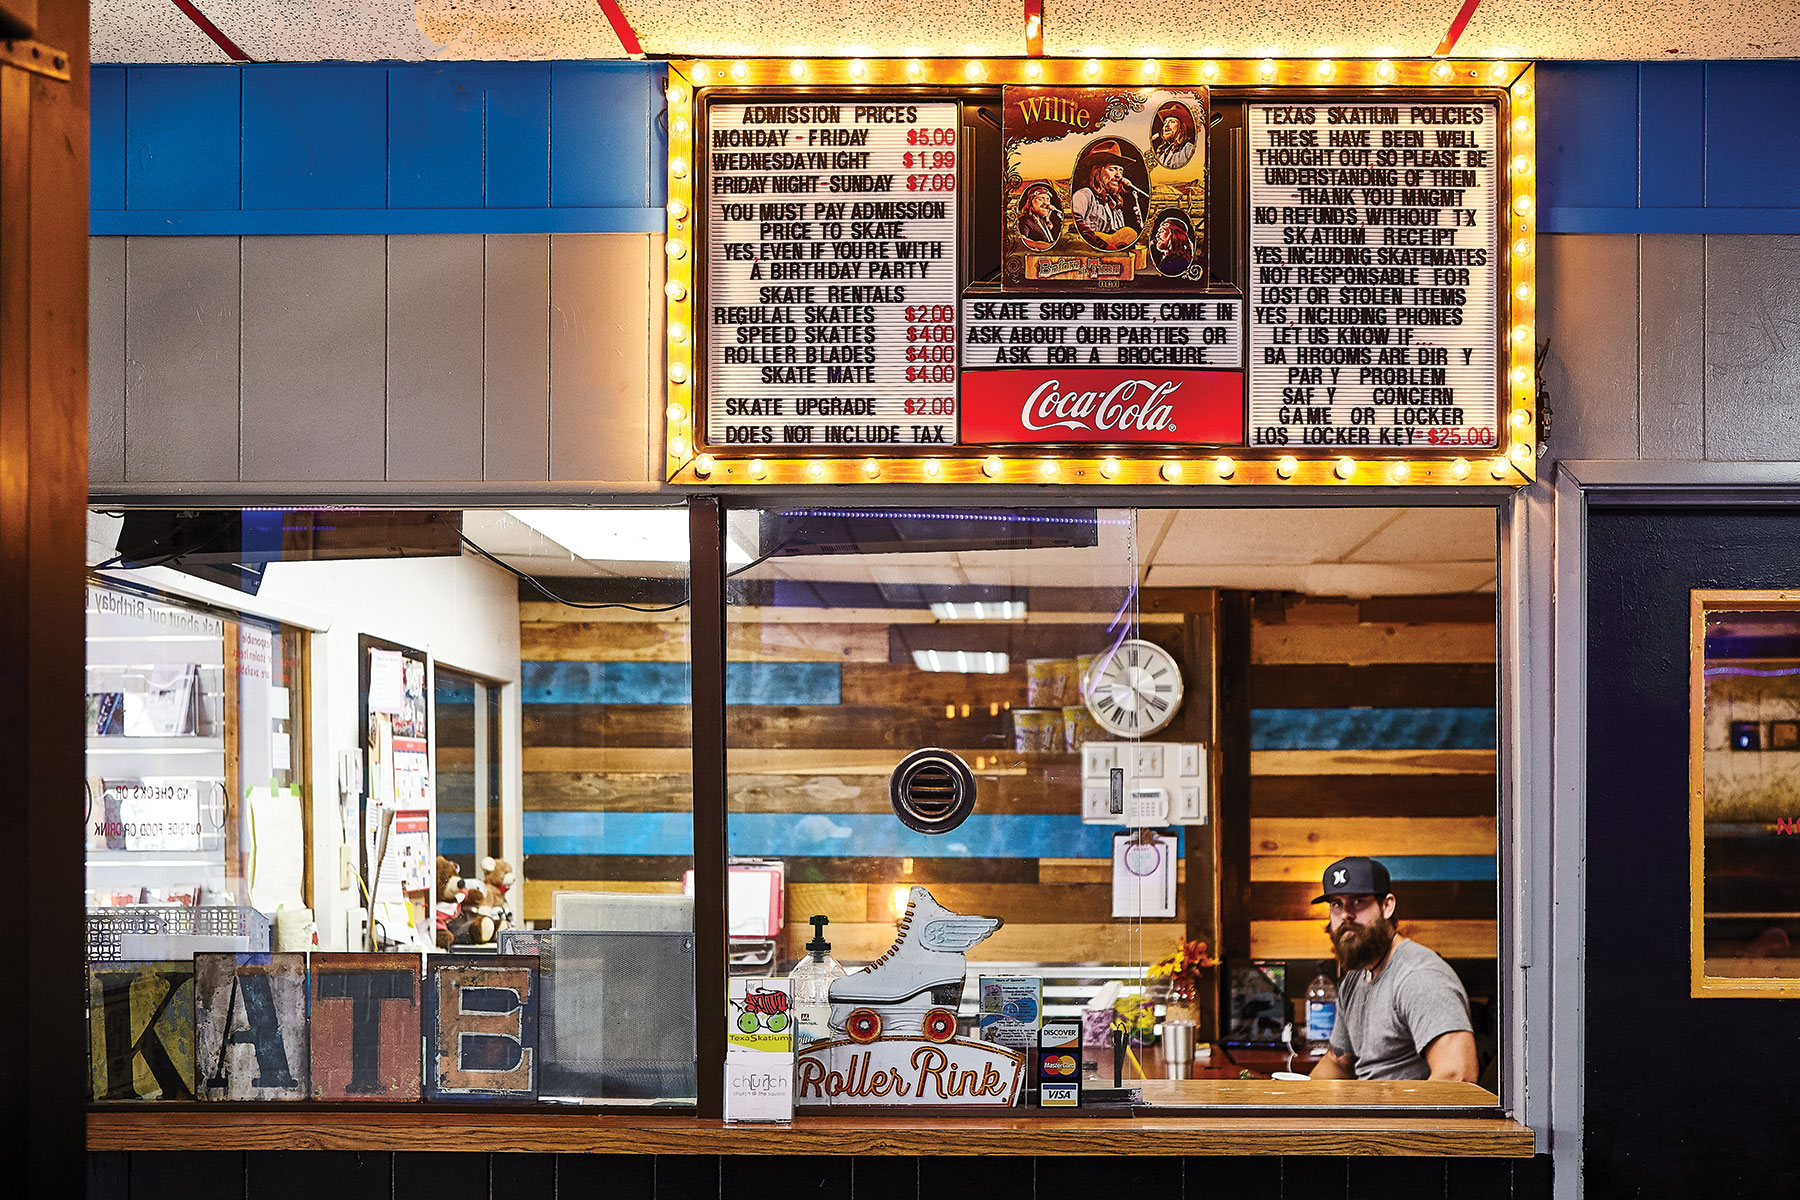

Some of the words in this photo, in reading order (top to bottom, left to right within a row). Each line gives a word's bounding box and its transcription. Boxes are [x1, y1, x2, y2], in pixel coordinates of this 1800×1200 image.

[742, 106, 840, 124] ADMISSION
[855, 106, 917, 123] PRICES
[1018, 96, 1091, 129] Willie
[1262, 107, 1316, 124] TEXAS
[1327, 106, 1399, 125] SKATIUM
[1410, 106, 1484, 124] POLICIES
[713, 129, 788, 147] MONDAY
[808, 129, 868, 146] FRIDAY
[906, 129, 956, 147] $5.00
[1267, 130, 1318, 147] THESE
[1329, 130, 1371, 147] HAVE
[1382, 130, 1424, 147] BEEN
[1436, 130, 1479, 148] WELL
[903, 151, 956, 170] $1.99
[1256, 150, 1335, 167] THOUGHT
[1404, 150, 1461, 167] PLEASE
[1467, 150, 1488, 167] BE
[713, 175, 767, 194] FRIDAY
[906, 174, 956, 192] $7.00
[1265, 168, 1398, 186] UNDERSTANDING
[1404, 169, 1424, 186] OF
[1362, 189, 1394, 206] YOU
[1402, 189, 1466, 206] MNGMT
[721, 203, 756, 221] YOU
[759, 203, 807, 221] MUST
[814, 203, 846, 220] PAY
[851, 201, 945, 220] ADMISSION
[1255, 207, 1278, 225] NO
[760, 222, 812, 240] PRICE
[820, 222, 844, 240] TO
[1283, 227, 1366, 245] SKATIUM
[1383, 228, 1458, 245] RECEIPT
[810, 242, 826, 260] IF
[895, 242, 942, 260] WITH
[1377, 248, 1487, 266] SKATEMATES
[750, 261, 763, 280] A
[770, 261, 861, 280] BIRTHDAY
[868, 261, 929, 280] PARTY
[1260, 267, 1292, 285] NOT
[1300, 267, 1419, 286] RESPONSABLE
[1434, 268, 1470, 286] FOR
[759, 286, 815, 304] SKATE
[828, 286, 905, 303] RENTALS
[1261, 287, 1305, 305] LOST
[1306, 287, 1330, 304] OR
[1339, 287, 1403, 305] STOLEN
[1413, 288, 1467, 306] ITEMS
[804, 306, 875, 324] SKATES
[904, 305, 955, 323] $2.00
[973, 302, 1029, 320] SKATE
[1039, 302, 1086, 320] SHOP
[1216, 302, 1233, 320] IN
[1299, 307, 1387, 326] INCLUDING
[1395, 307, 1463, 326] PHONES
[736, 326, 797, 344] SPEED
[804, 326, 876, 344] SKATES
[905, 326, 956, 343] $4.00
[966, 327, 1002, 344] ASK
[1009, 327, 1068, 344] ABOUT
[1076, 326, 1111, 344] OUR
[1117, 326, 1190, 344] PARTIES
[1203, 326, 1227, 344] OR
[1273, 327, 1303, 345] LET
[1307, 327, 1329, 345] US
[1337, 327, 1391, 346] KNOW
[725, 346, 797, 364] ROLLER
[806, 346, 876, 364] BLADES
[905, 346, 956, 363] $4.00
[995, 346, 1032, 364] ASK
[1048, 346, 1078, 364] FOR
[1088, 346, 1101, 363] A
[1378, 348, 1411, 366] ARE
[761, 366, 816, 384] SKATE
[827, 366, 876, 383] MATE
[905, 366, 956, 383] $4.00
[1360, 367, 1446, 385] PROBLEM
[1373, 387, 1454, 405] CONCERN
[726, 398, 783, 416] SKATE
[796, 397, 876, 416] UPGRADE
[904, 398, 956, 415] $2.00
[1279, 406, 1332, 425] GAME
[1351, 407, 1376, 425] OR
[1394, 407, 1464, 425] LOCKER
[726, 426, 773, 444] DOES
[783, 425, 814, 444] NOT
[825, 425, 900, 443] INCLUDE
[911, 425, 944, 443] TAX
[1256, 427, 1289, 446] LOS
[1303, 427, 1370, 446] LOCKER
[729, 1034, 792, 1042] TexaSkatium
[799, 1051, 911, 1098] Roller
[911, 1046, 1007, 1099] Rink
[1048, 1091, 1071, 1099] VISA
